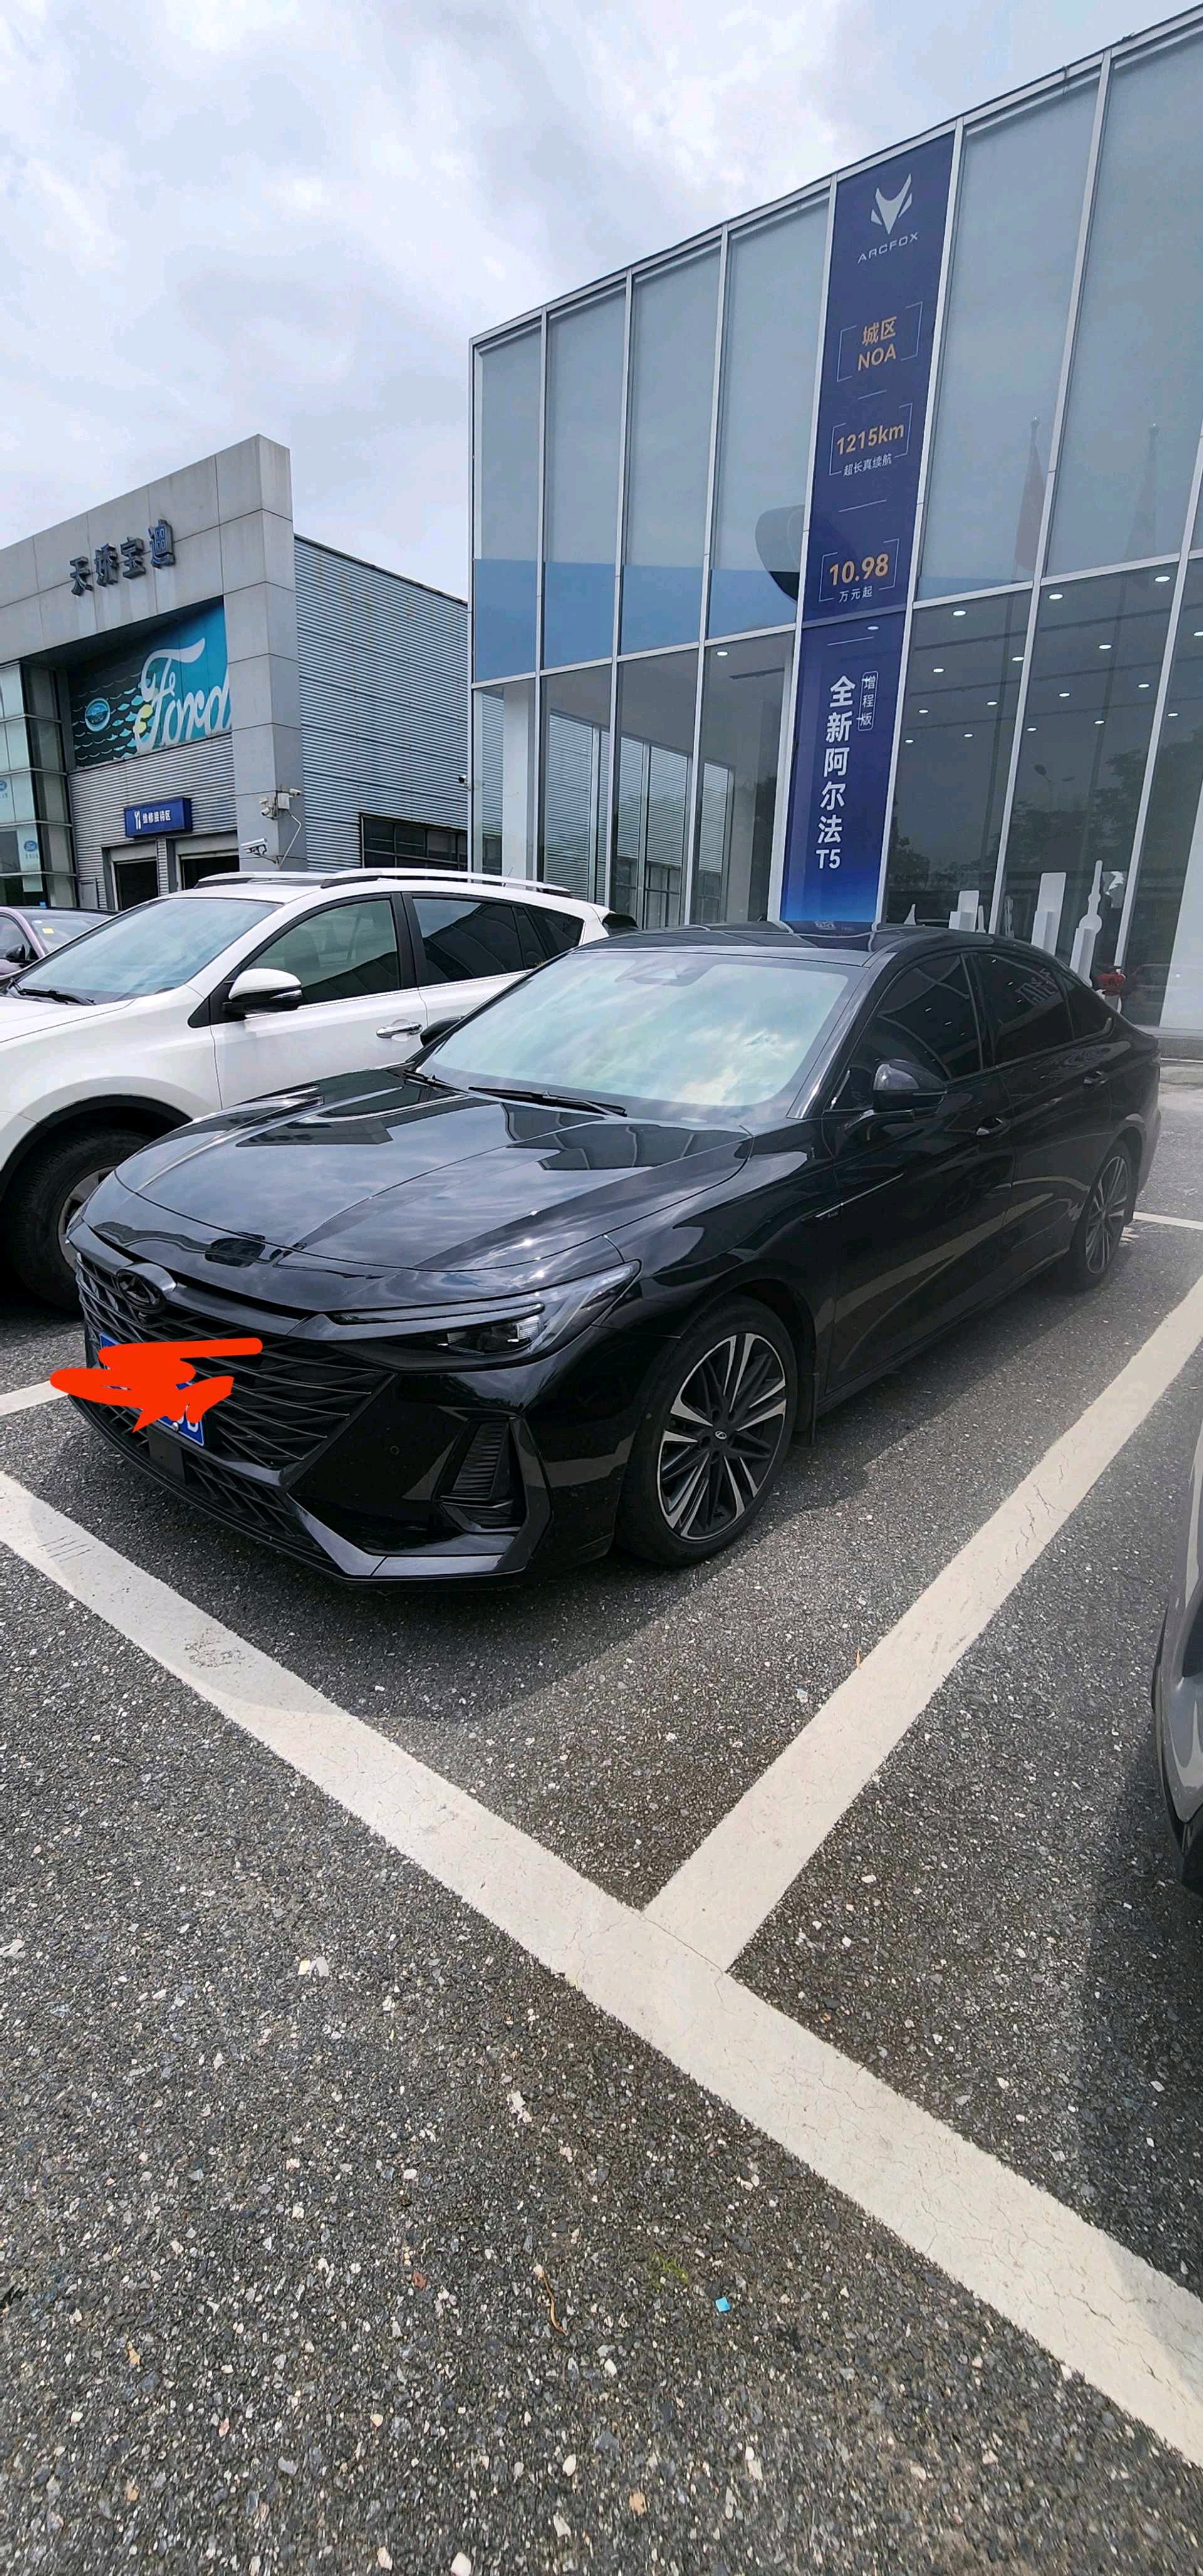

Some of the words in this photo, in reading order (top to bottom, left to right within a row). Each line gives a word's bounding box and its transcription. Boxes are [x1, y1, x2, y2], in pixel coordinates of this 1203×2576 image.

[857, 232, 919, 264] ARCFOX
[862, 316, 897, 346] 城区
[857, 344, 897, 371] NOA
[836, 424, 904, 456] 1215km
[843, 453, 892, 476] 超长真续航
[829, 553, 888, 585] 10.98
[838, 585, 873, 602] 万元起
[133, 637, 232, 753] Ford
[860, 675, 876, 726] 增程版
[817, 675, 856, 845] 全新阿尔法
[816, 848, 841, 869] T5
